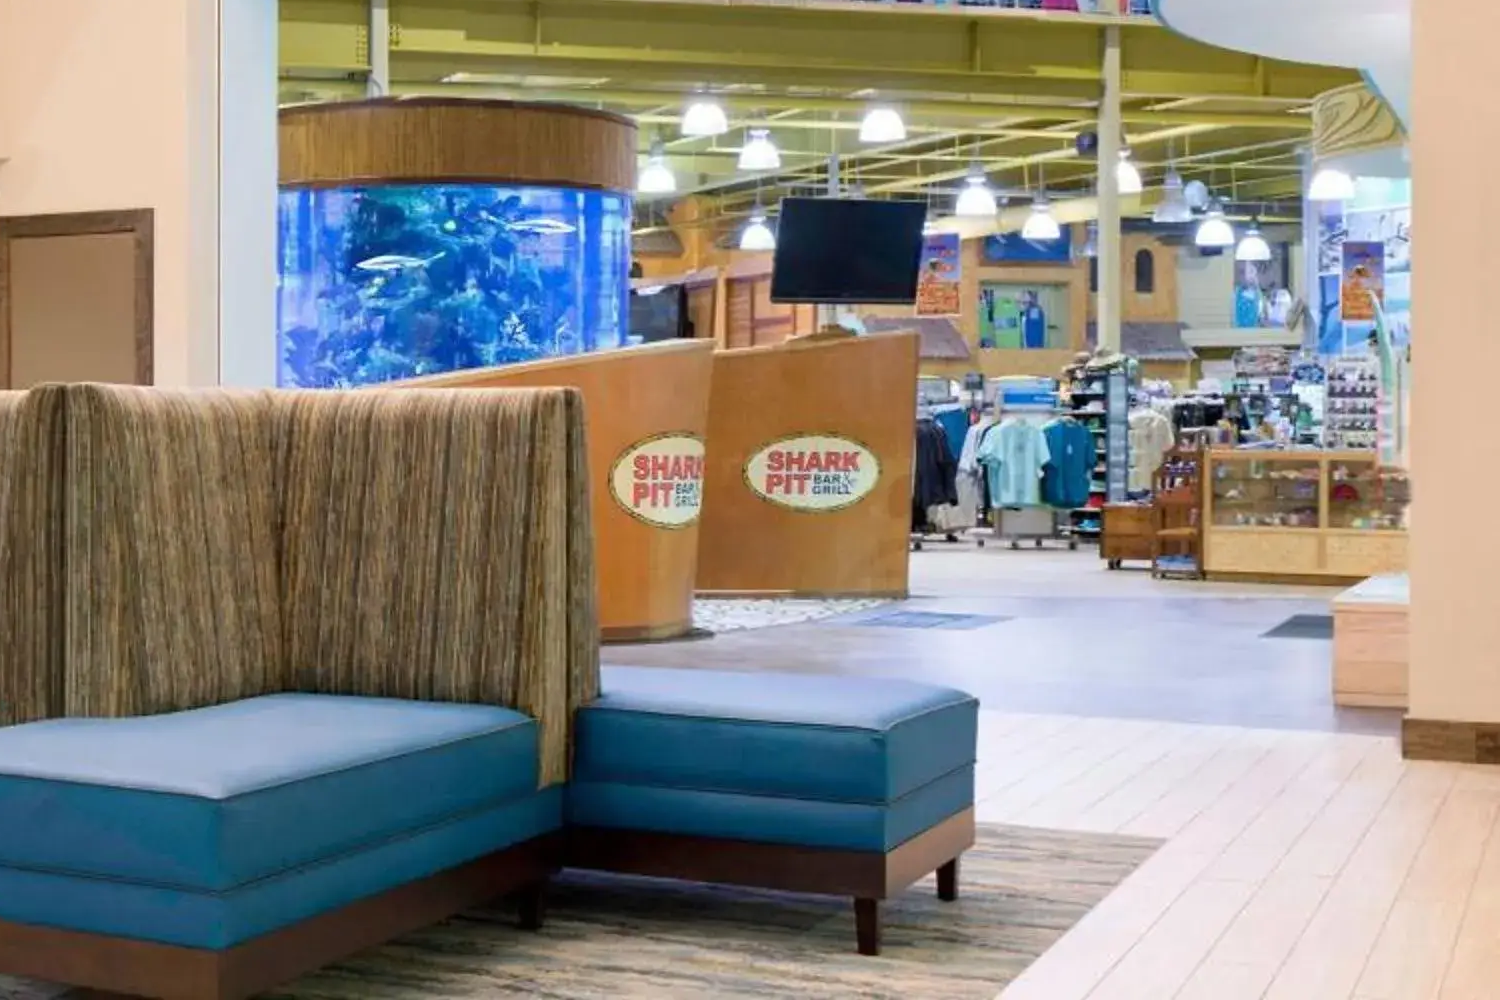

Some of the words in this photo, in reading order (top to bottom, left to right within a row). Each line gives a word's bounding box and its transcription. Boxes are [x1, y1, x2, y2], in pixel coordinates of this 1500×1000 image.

[766, 450, 860, 472] SHARK
[765, 473, 812, 495] PIT
[812, 485, 852, 495] GRILL
[813, 474, 841, 485] BAR
[633, 483, 674, 508] PIT
